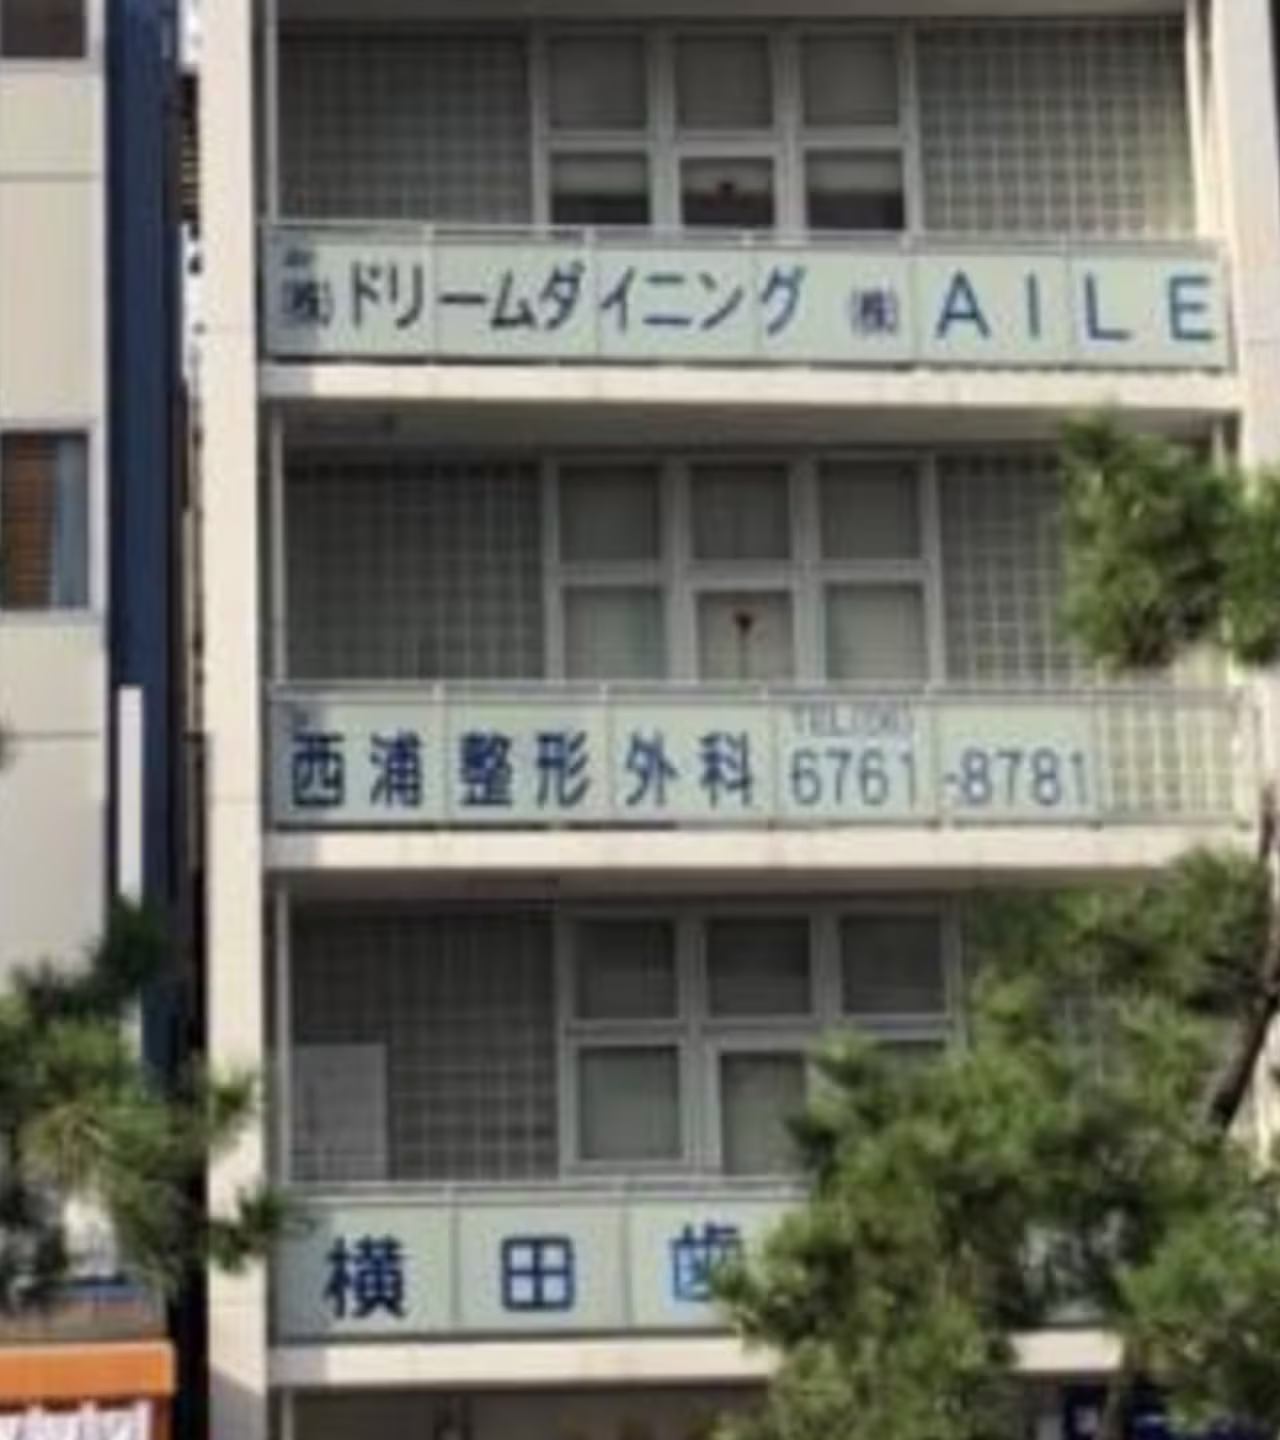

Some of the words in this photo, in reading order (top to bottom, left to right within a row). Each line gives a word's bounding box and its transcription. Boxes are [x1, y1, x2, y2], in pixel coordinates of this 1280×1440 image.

[936, 273, 1216, 342] AILE
[290, 727, 756, 809] 西浦整形外科
